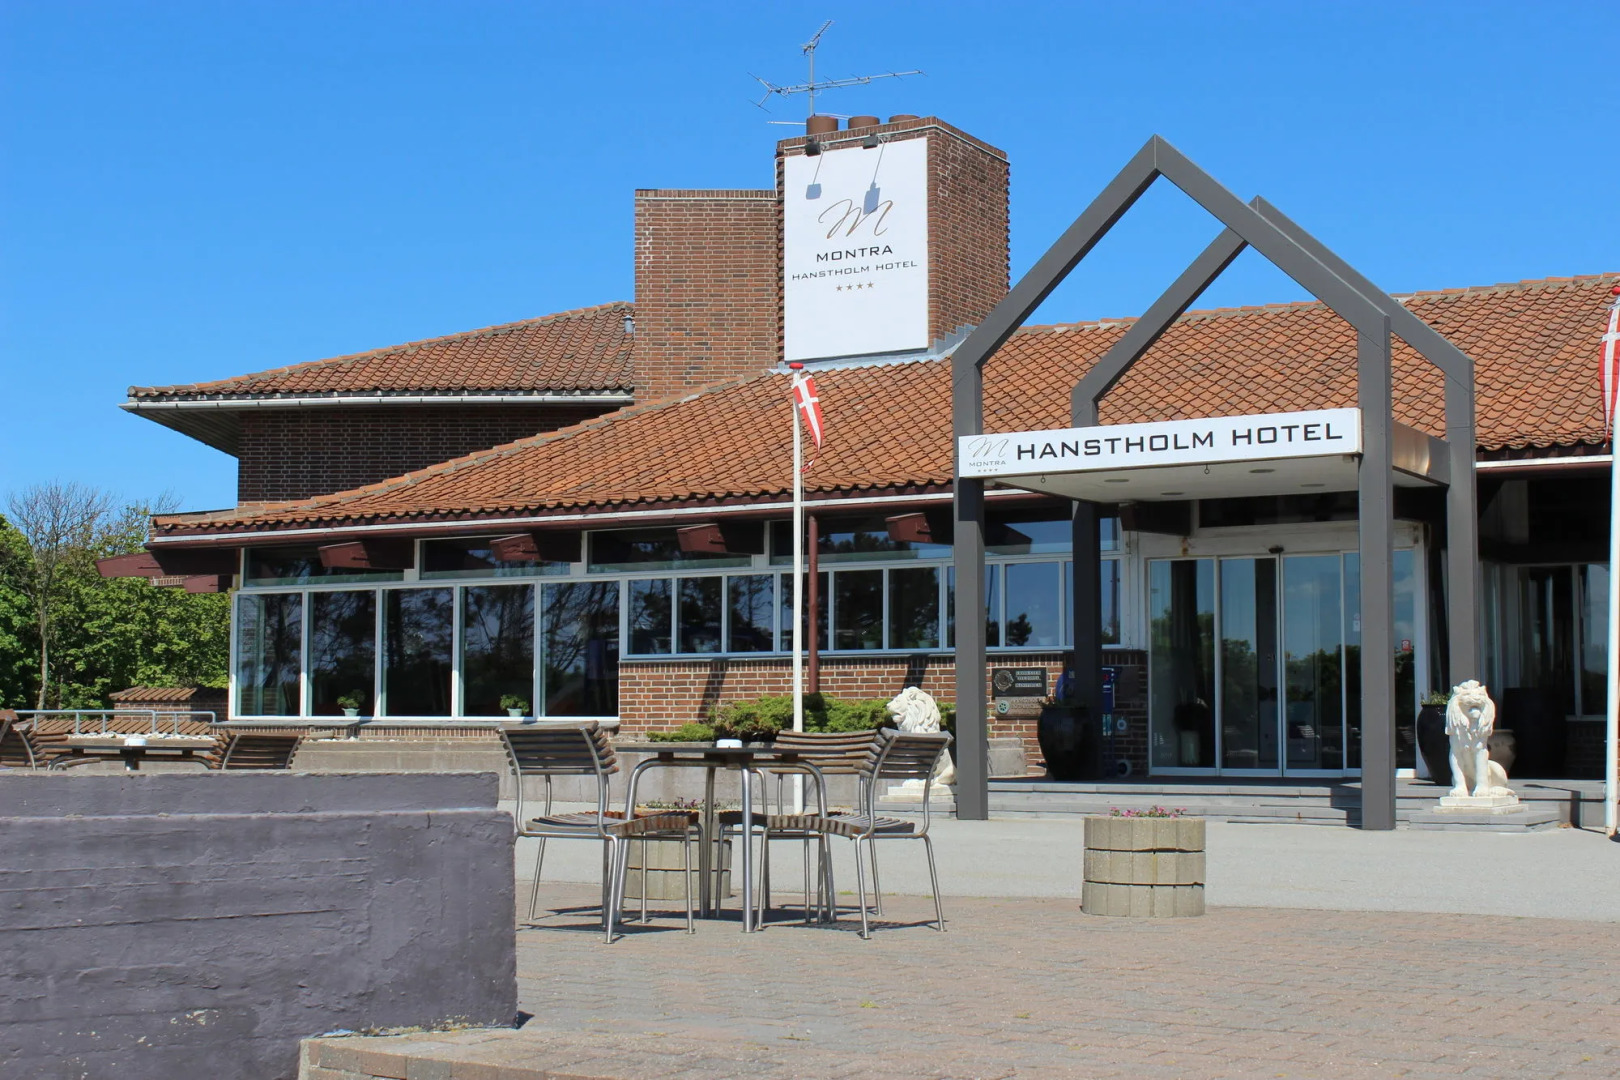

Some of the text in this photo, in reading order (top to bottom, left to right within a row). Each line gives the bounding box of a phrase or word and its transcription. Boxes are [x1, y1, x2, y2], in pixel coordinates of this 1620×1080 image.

[816, 245, 893, 262] MONTRA
[792, 260, 918, 280] HANSTHOLM HOTEL
[1017, 423, 1343, 460] HANSTHOLM HOTEL
